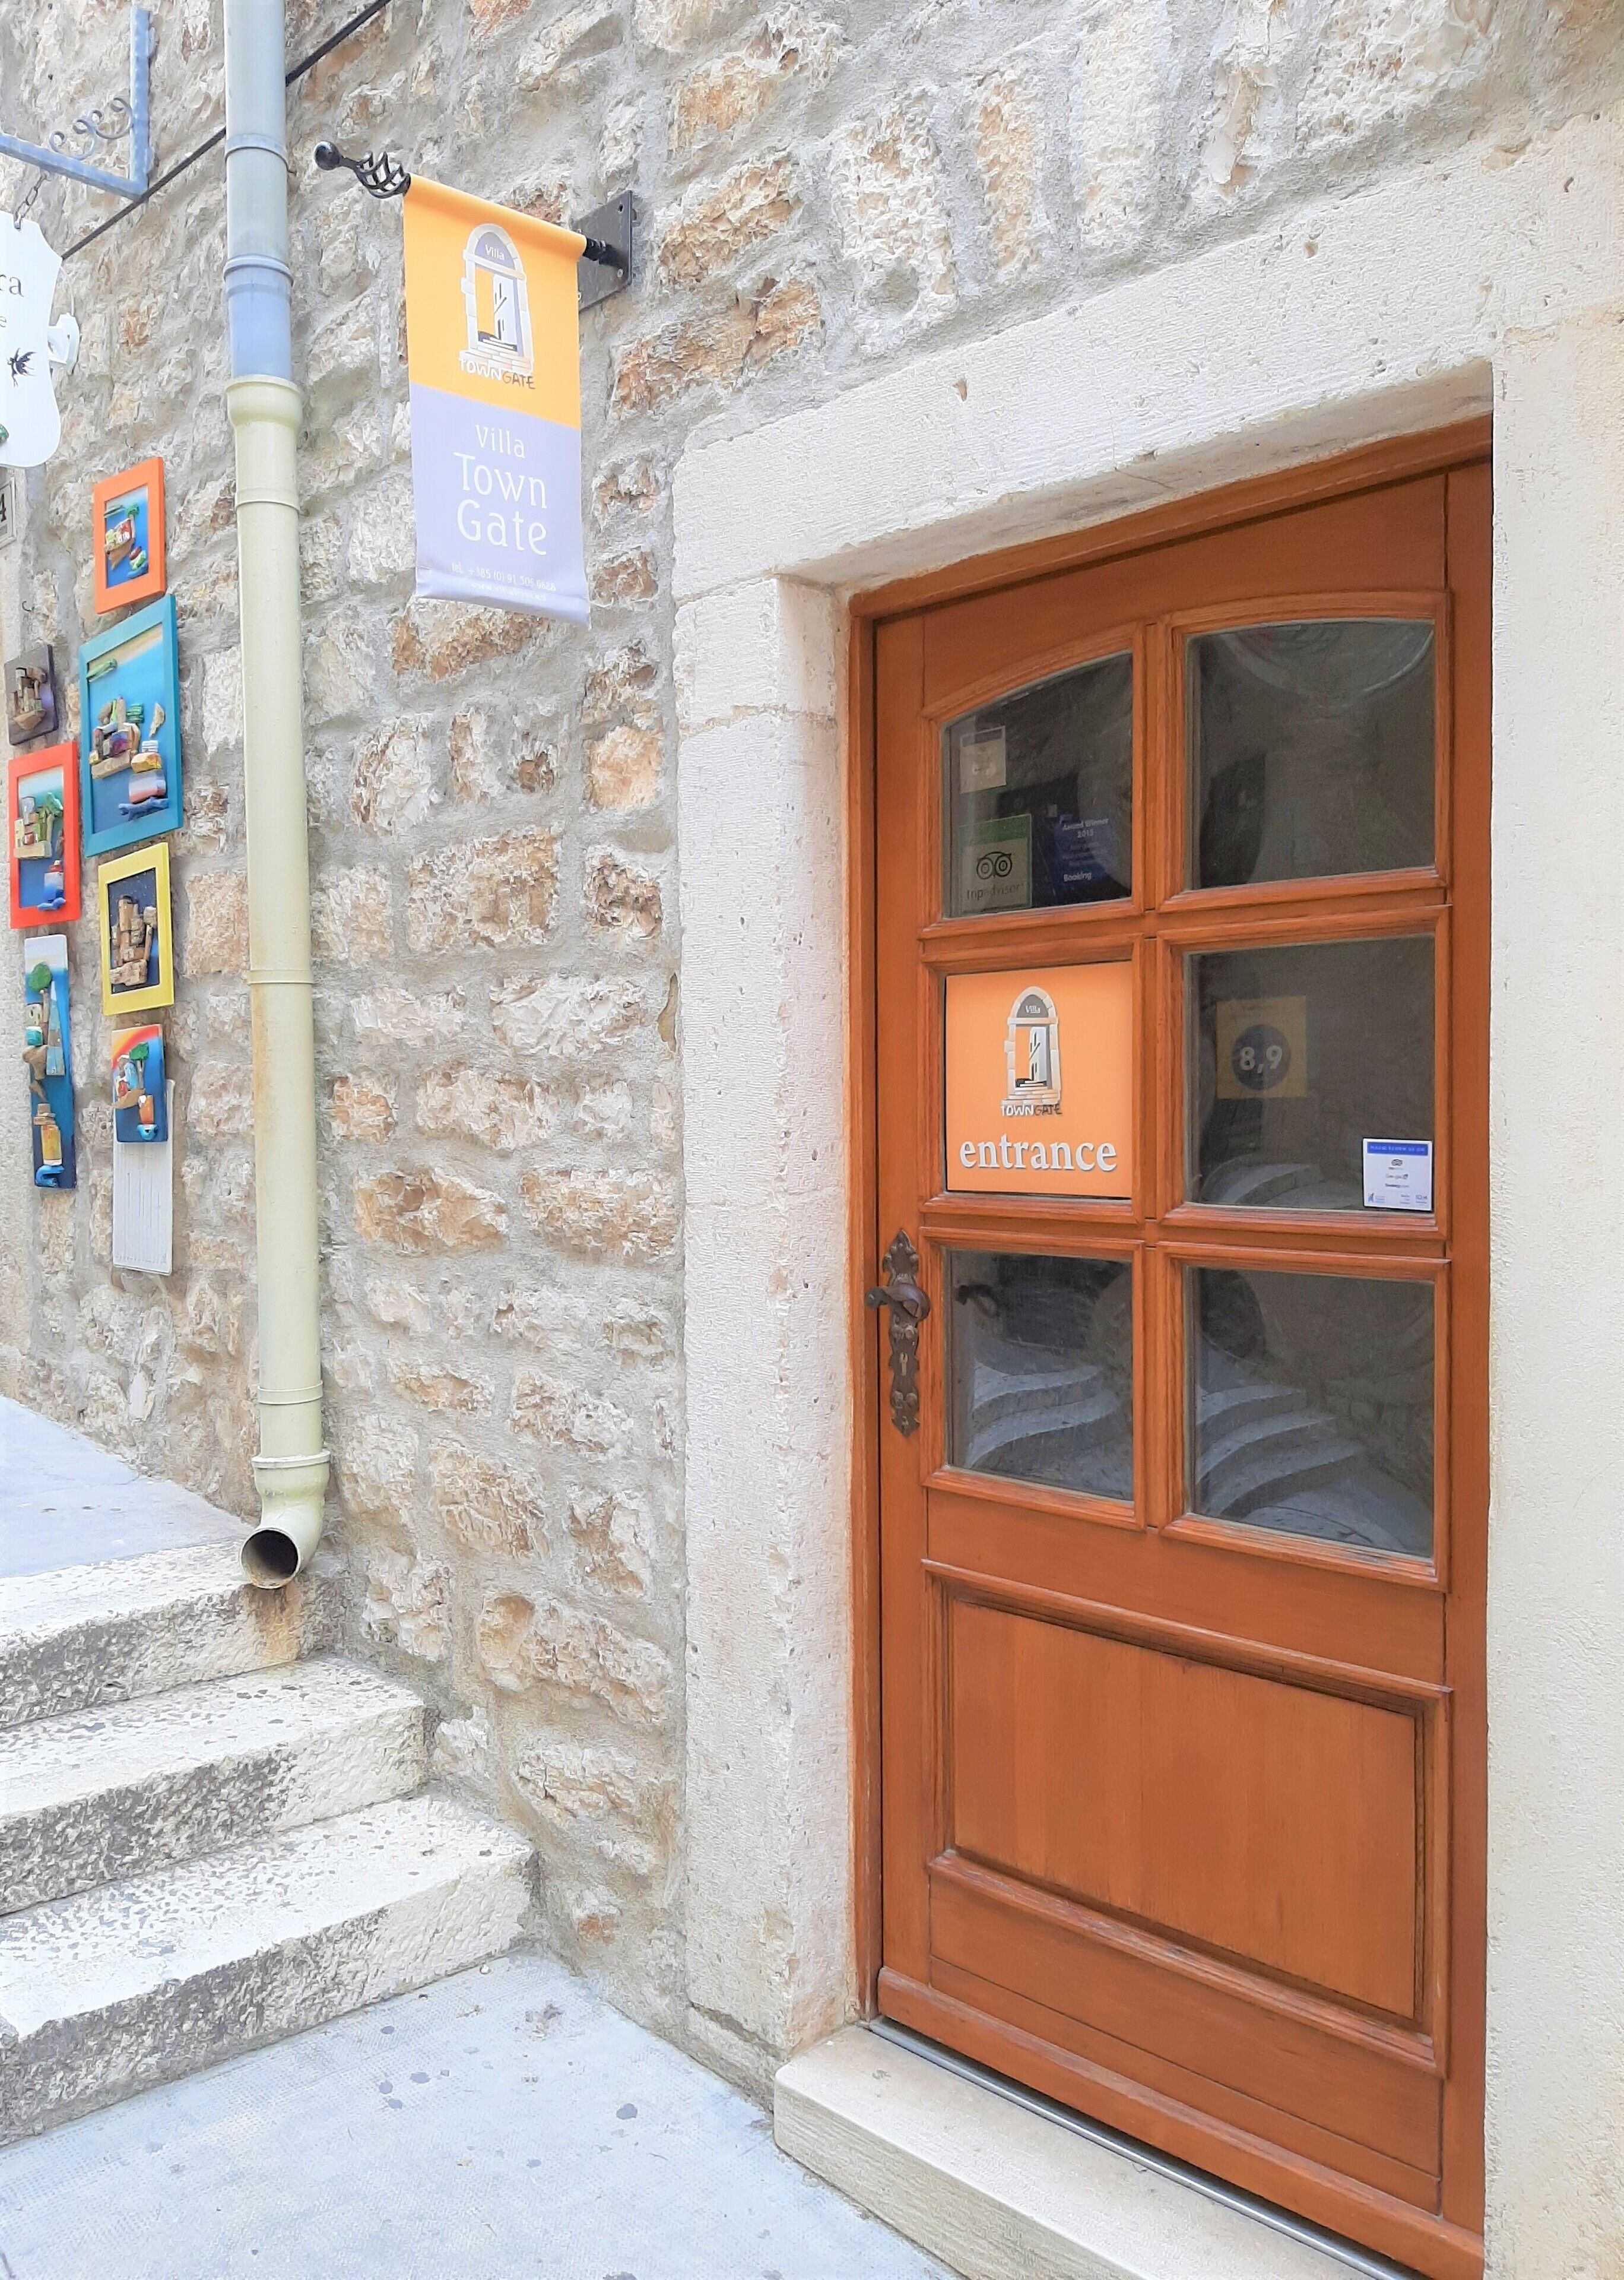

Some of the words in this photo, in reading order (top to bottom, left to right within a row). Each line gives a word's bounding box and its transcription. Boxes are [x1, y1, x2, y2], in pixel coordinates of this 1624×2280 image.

[484, 244, 505, 261] Villa
[475, 424, 525, 459] Villa
[453, 451, 547, 509] Town
[457, 499, 547, 556] Gate
[1239, 1045, 1283, 1074] 8,9
[959, 1133, 1117, 1171] entrance
